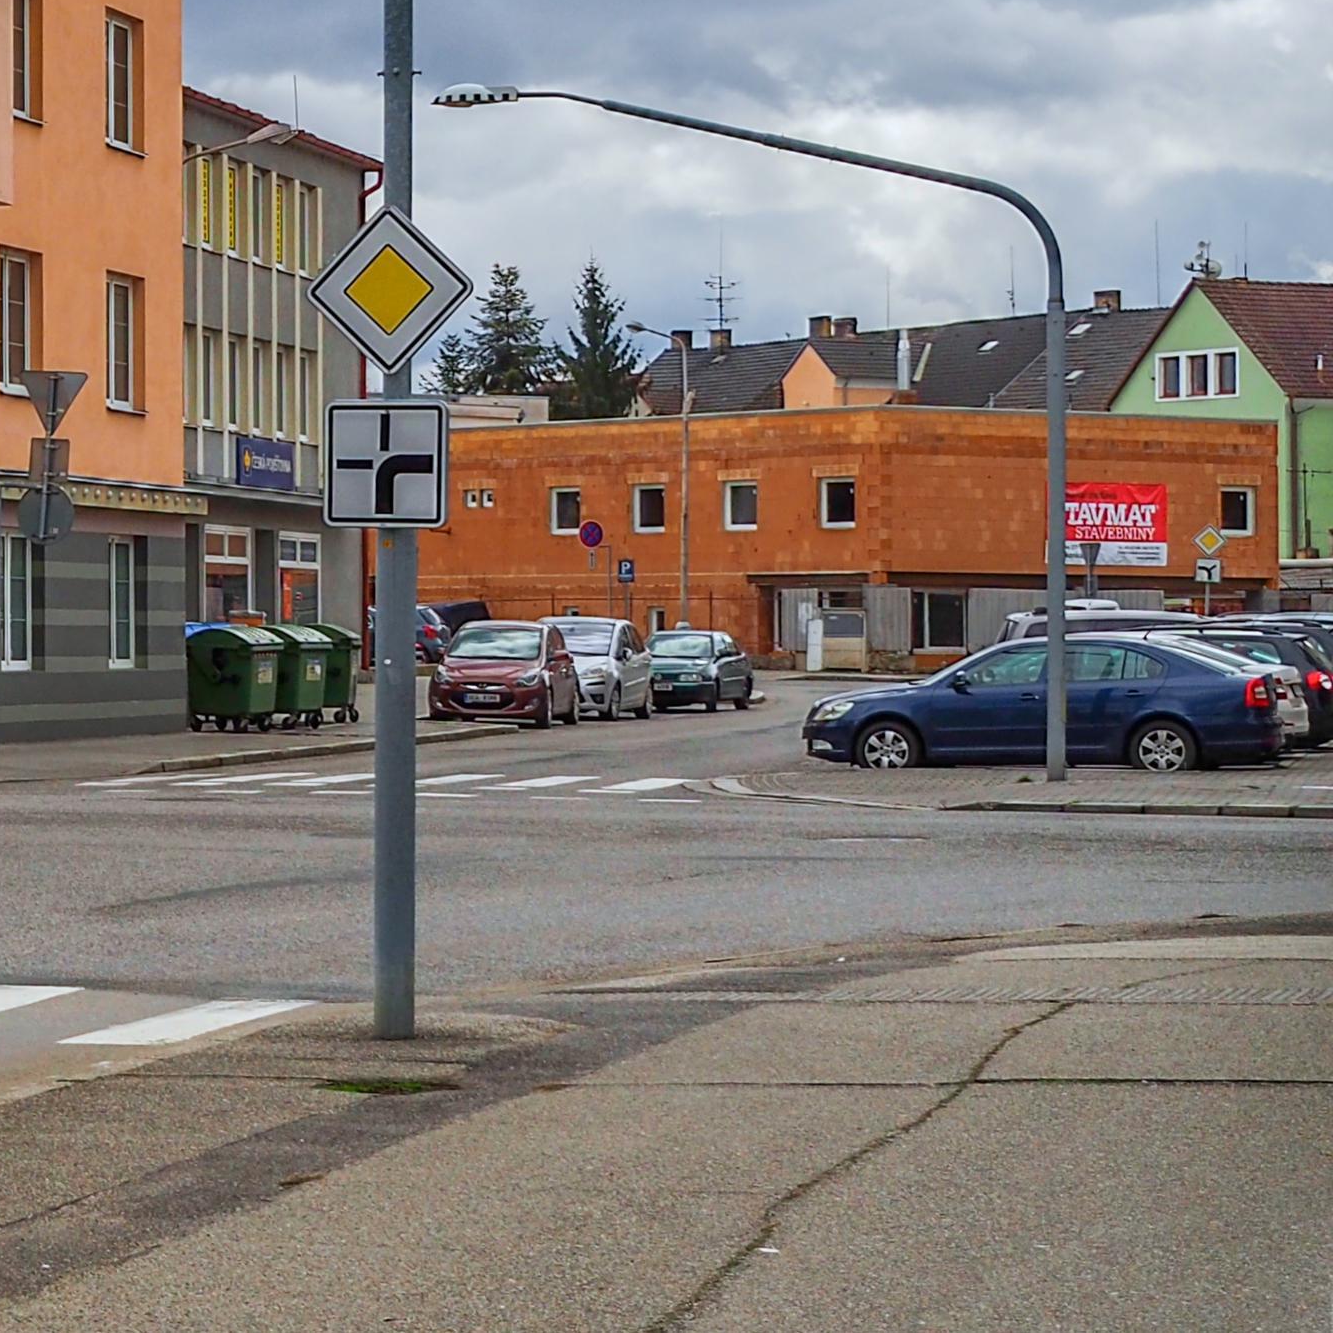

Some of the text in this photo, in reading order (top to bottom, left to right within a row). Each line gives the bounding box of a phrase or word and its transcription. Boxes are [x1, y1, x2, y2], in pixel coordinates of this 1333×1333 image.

[1065, 502, 1156, 526] TAVMAT
[1075, 526, 1155, 540] STAVEBNINY
[621, 561, 631, 573] P
